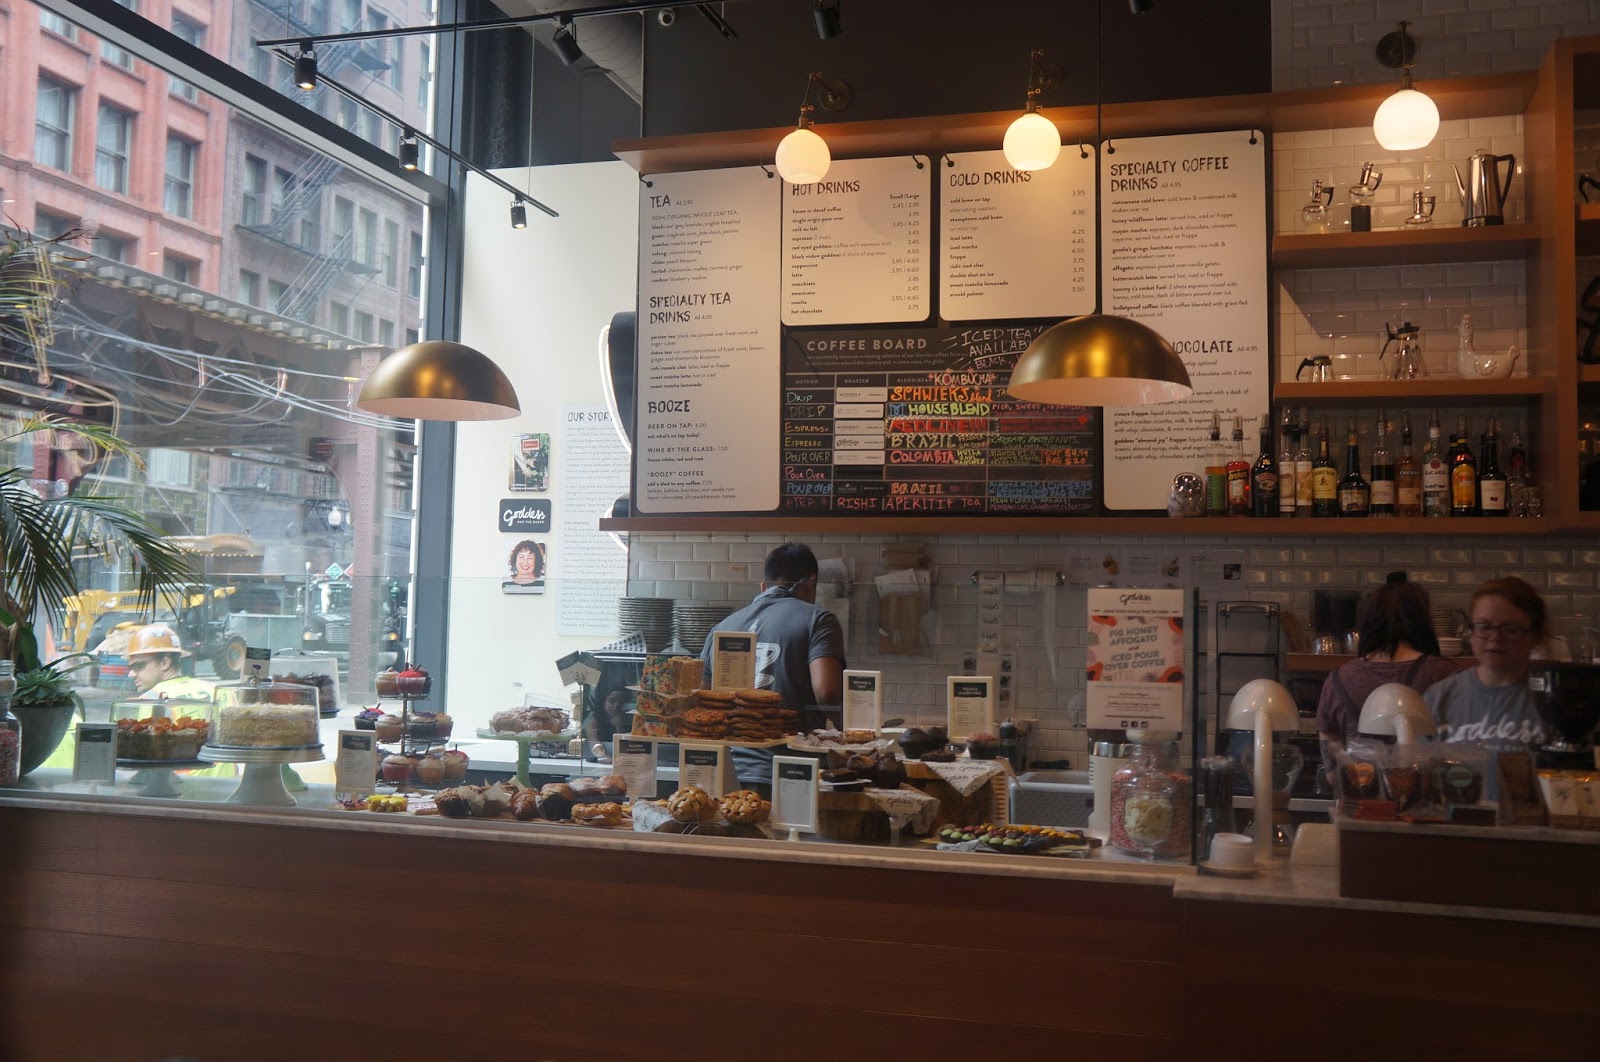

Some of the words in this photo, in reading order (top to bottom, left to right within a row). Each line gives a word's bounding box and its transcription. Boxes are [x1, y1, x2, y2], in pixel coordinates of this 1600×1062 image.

[1111, 160, 1176, 176] SPECIALTY
[1182, 157, 1229, 172] COFFEE
[950, 173, 979, 186] COLD
[984, 170, 1032, 184] DRINKS
[1111, 177, 1158, 192] DRINKS
[793, 184, 813, 195] HOT
[817, 181, 860, 194] DRINKS
[650, 195, 670, 208] TEA
[650, 294, 707, 308] SPECIALTY
[710, 292, 731, 305] TEA
[650, 311, 691, 324] DRINKS
[961, 329, 1004, 346] ICED
[1007, 328, 1031, 339] TEA
[807, 340, 866, 351] COFFEE
[873, 339, 927, 350] BOARD
[970, 340, 1032, 356] AVAILAB
[1173, 340, 1232, 354] OCOLATE
[648, 400, 690, 413] BOOZE
[790, 406, 826, 417] DRIP
[908, 403, 949, 415] HOUSE
[950, 403, 989, 416] BLEND
[568, 412, 584, 422] OUR
[588, 412, 612, 421] STOR
[892, 433, 956, 448] BRAZIL
[786, 452, 807, 463] POUR
[810, 451, 830, 462] OVER
[890, 449, 956, 464] COLOMBIA
[787, 482, 813, 495] POUR
[814, 484, 833, 494] OVER
[891, 483, 945, 494] BRAZIL
[838, 497, 877, 509] RISHI
[885, 497, 954, 510] APERITIF
[503, 505, 546, 526] Goddess
[1126, 626, 1158, 636] HONEY
[1110, 635, 1157, 646] AFFOGATO
[1111, 653, 1132, 662] ICED
[1134, 651, 1159, 659] POUR
[1104, 662, 1128, 670] OVER
[1132, 658, 1166, 668] COFFEE
